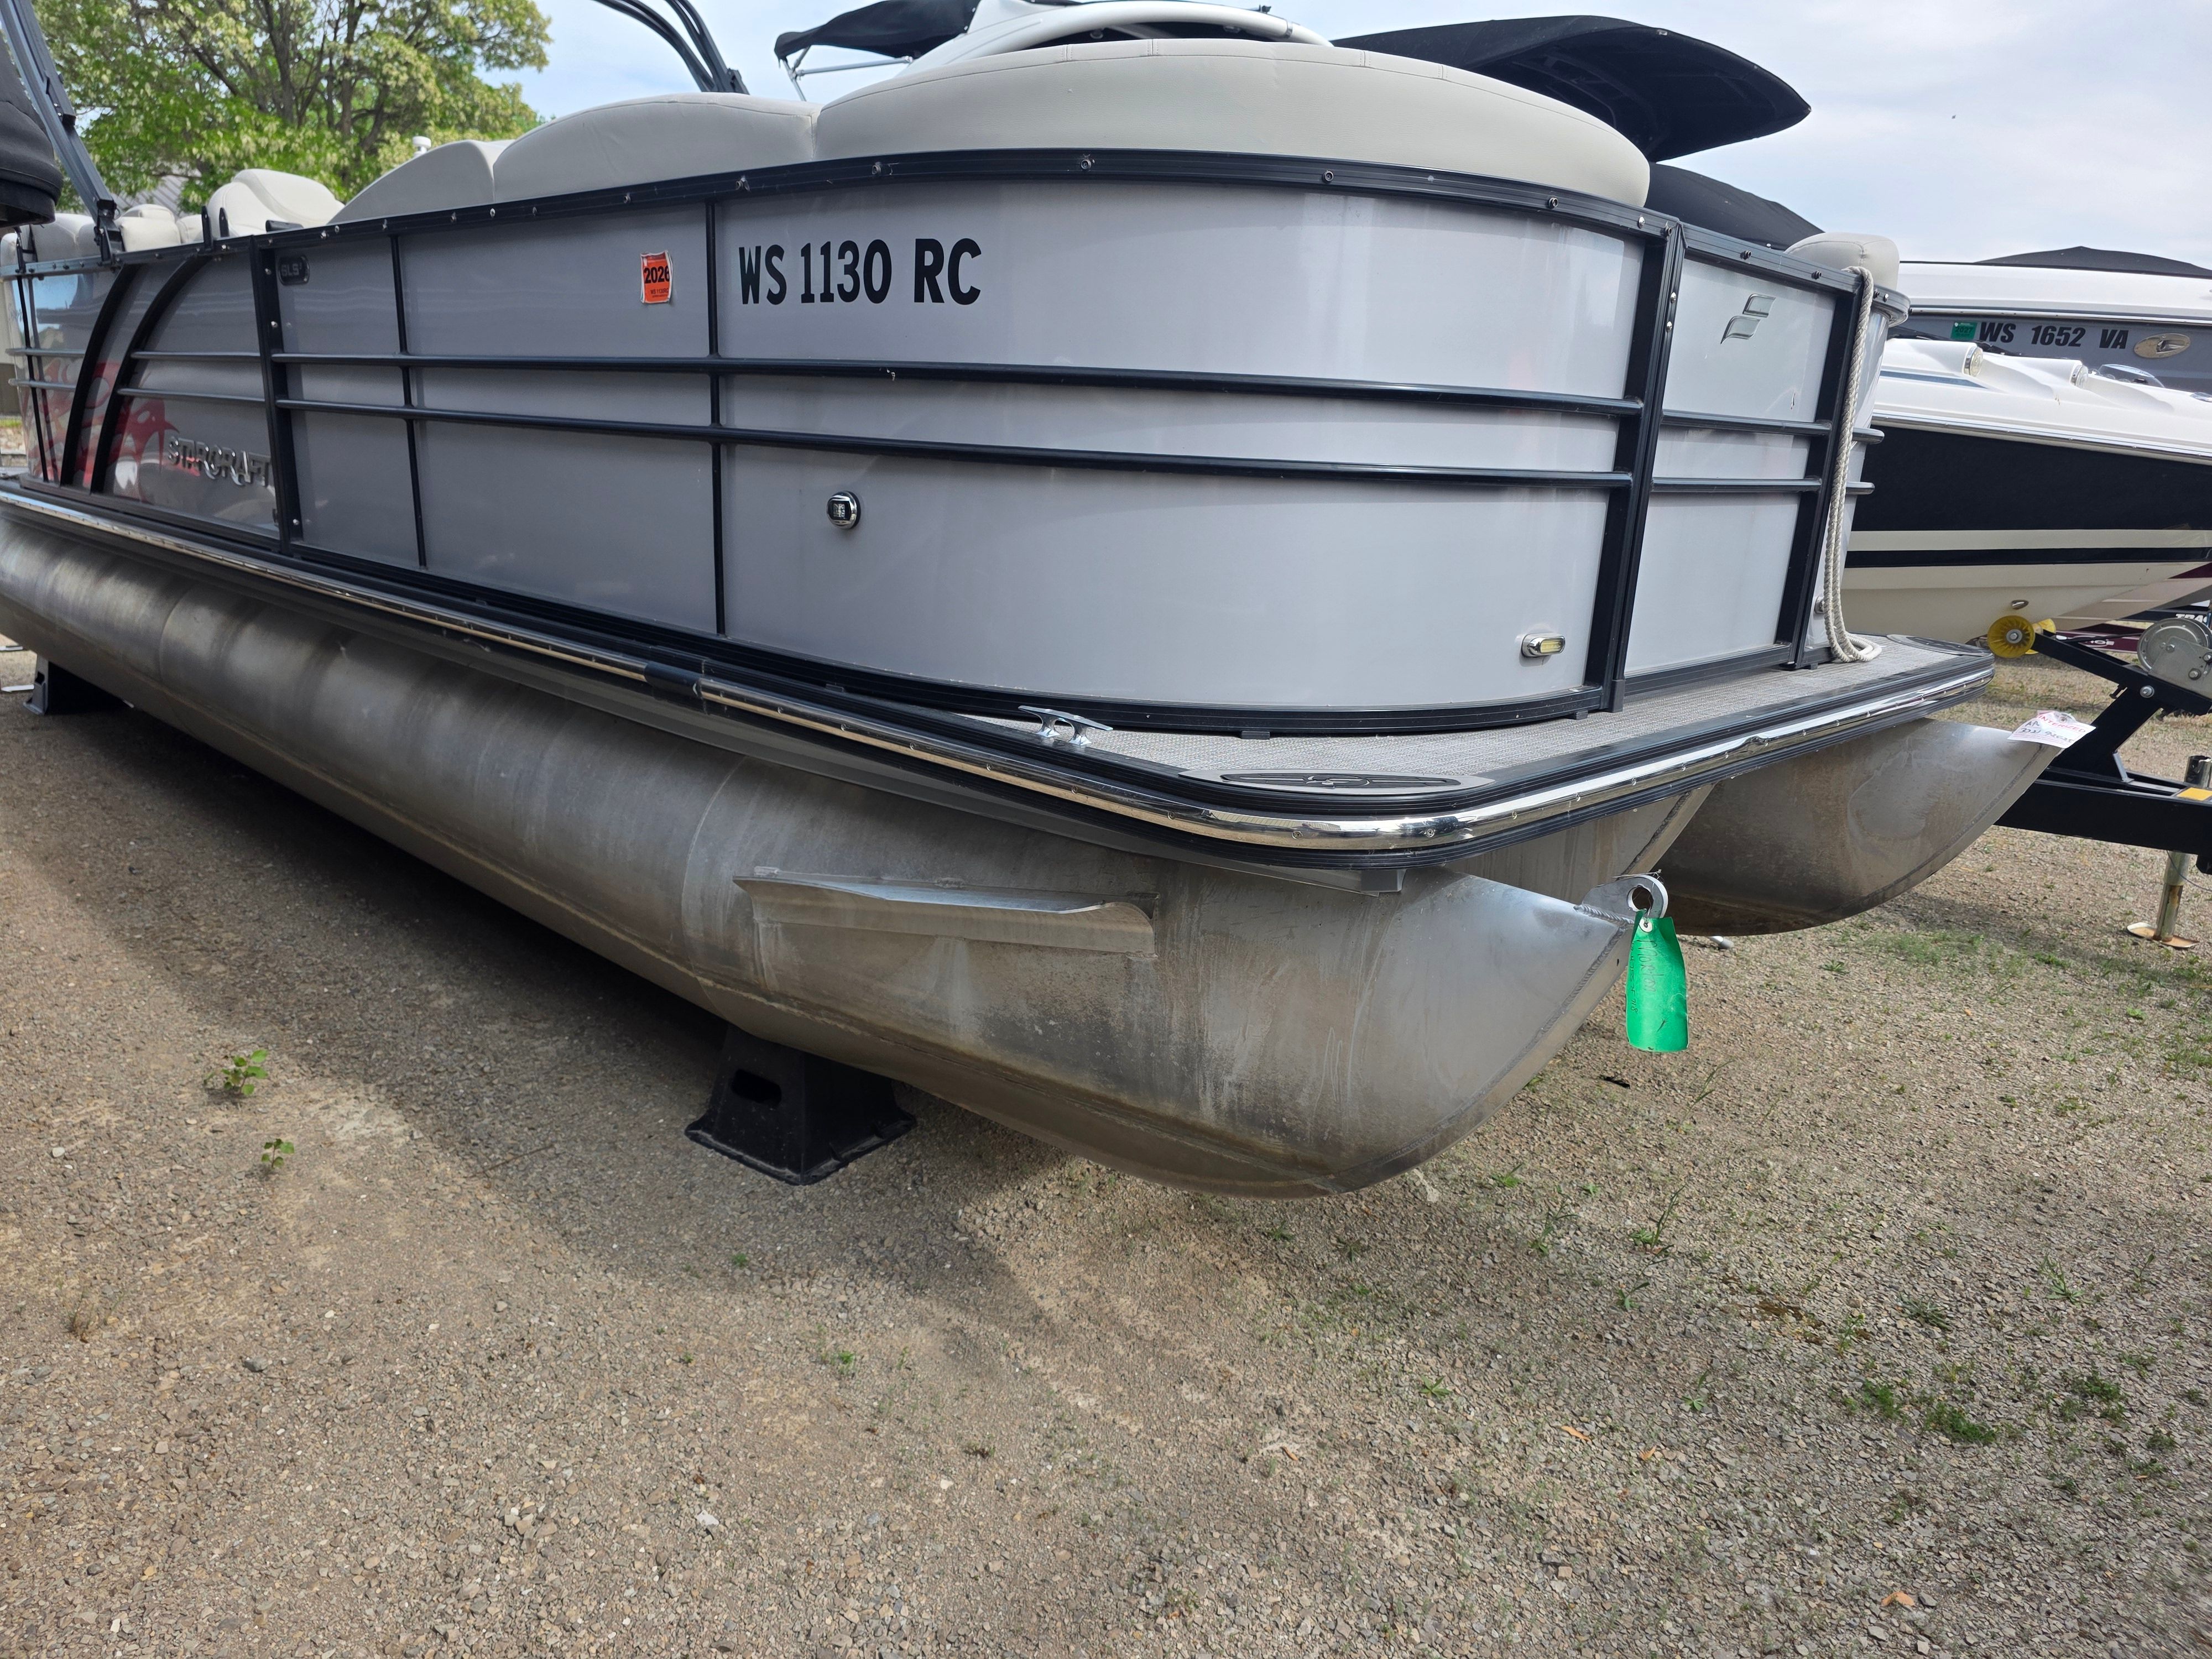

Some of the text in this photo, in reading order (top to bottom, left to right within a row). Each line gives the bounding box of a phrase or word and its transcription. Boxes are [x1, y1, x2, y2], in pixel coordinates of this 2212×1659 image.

[644, 266, 670, 284] 2026
[739, 238, 982, 305] WS 1130 RC
[1979, 322, 2129, 349] WS 1652 VA
[168, 436, 271, 487] STARCRAFT
[2038, 715, 2086, 733] INTERIZED
